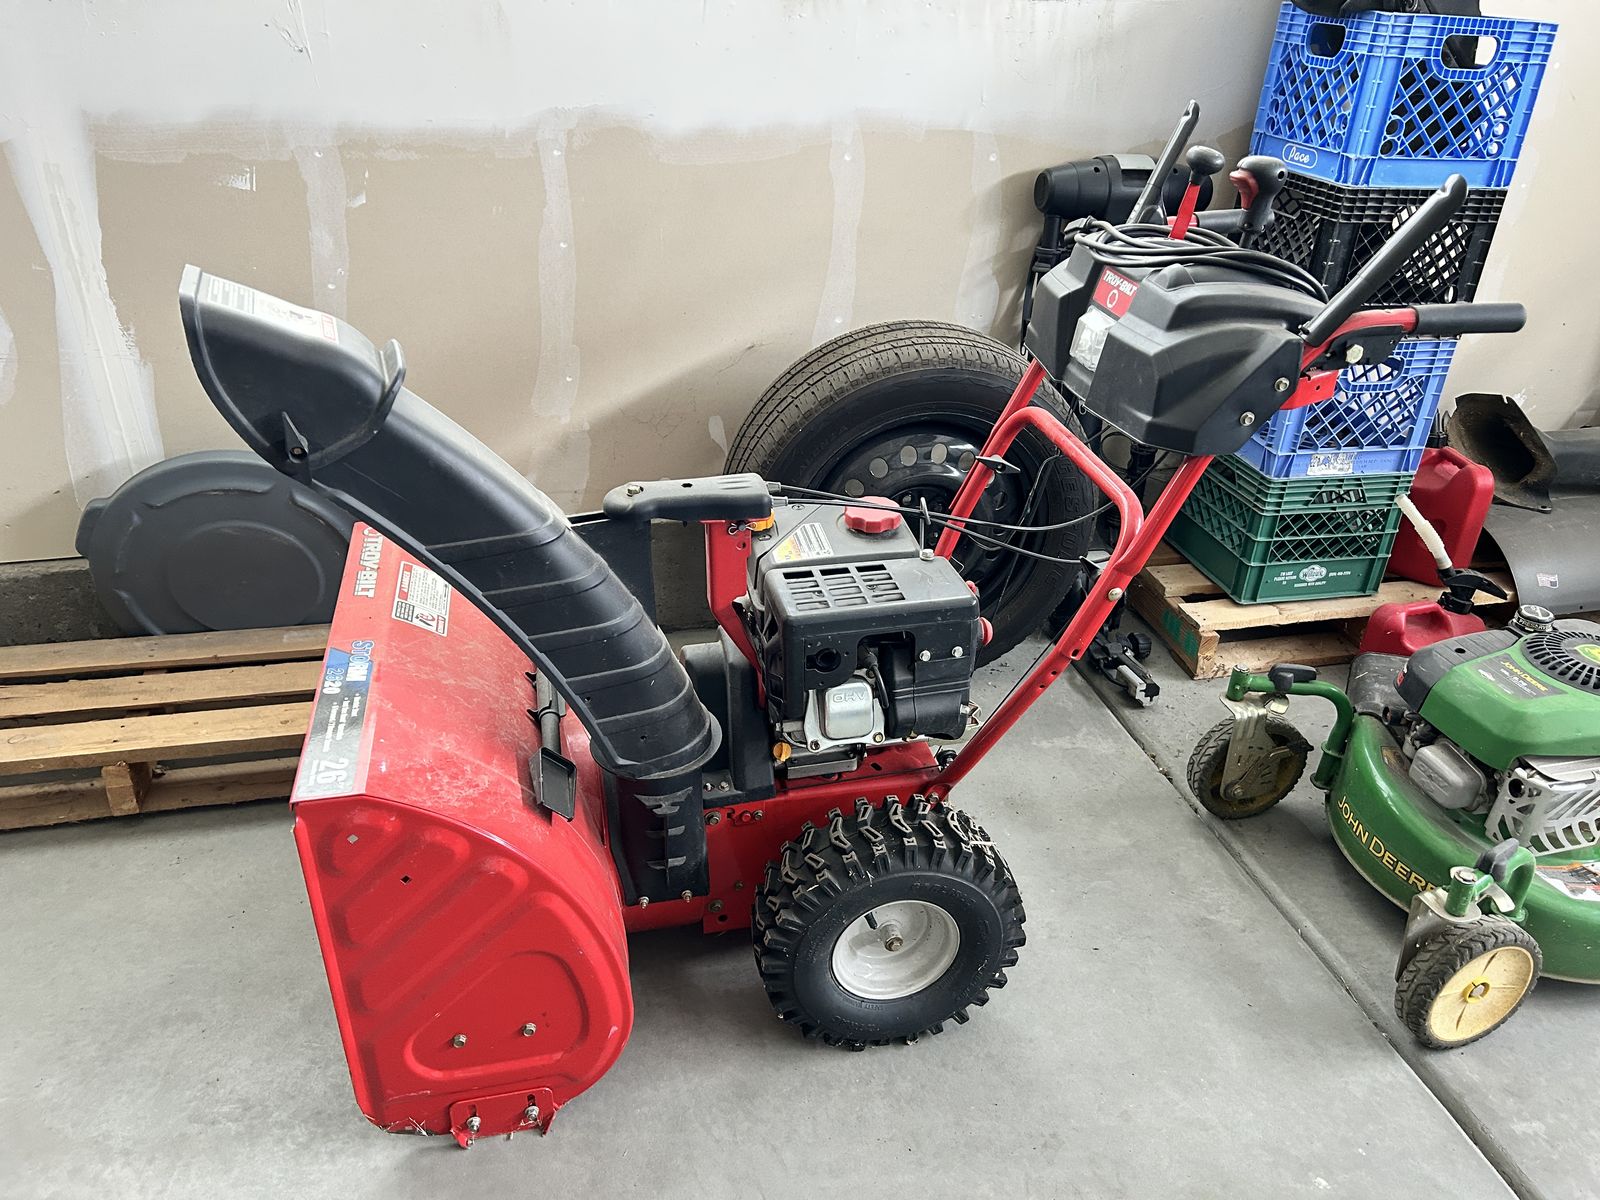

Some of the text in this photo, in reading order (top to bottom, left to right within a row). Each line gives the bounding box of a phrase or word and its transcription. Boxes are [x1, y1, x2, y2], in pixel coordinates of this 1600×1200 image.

[1288, 146, 1310, 163] Pace
[1103, 270, 1138, 297] TROY-BILT
[354, 535, 384, 598] TROY-BILT
[346, 640, 374, 681] STORM
[322, 667, 344, 695] 2620
[833, 689, 865, 702] OHV
[1338, 795, 1369, 844] JOHN
